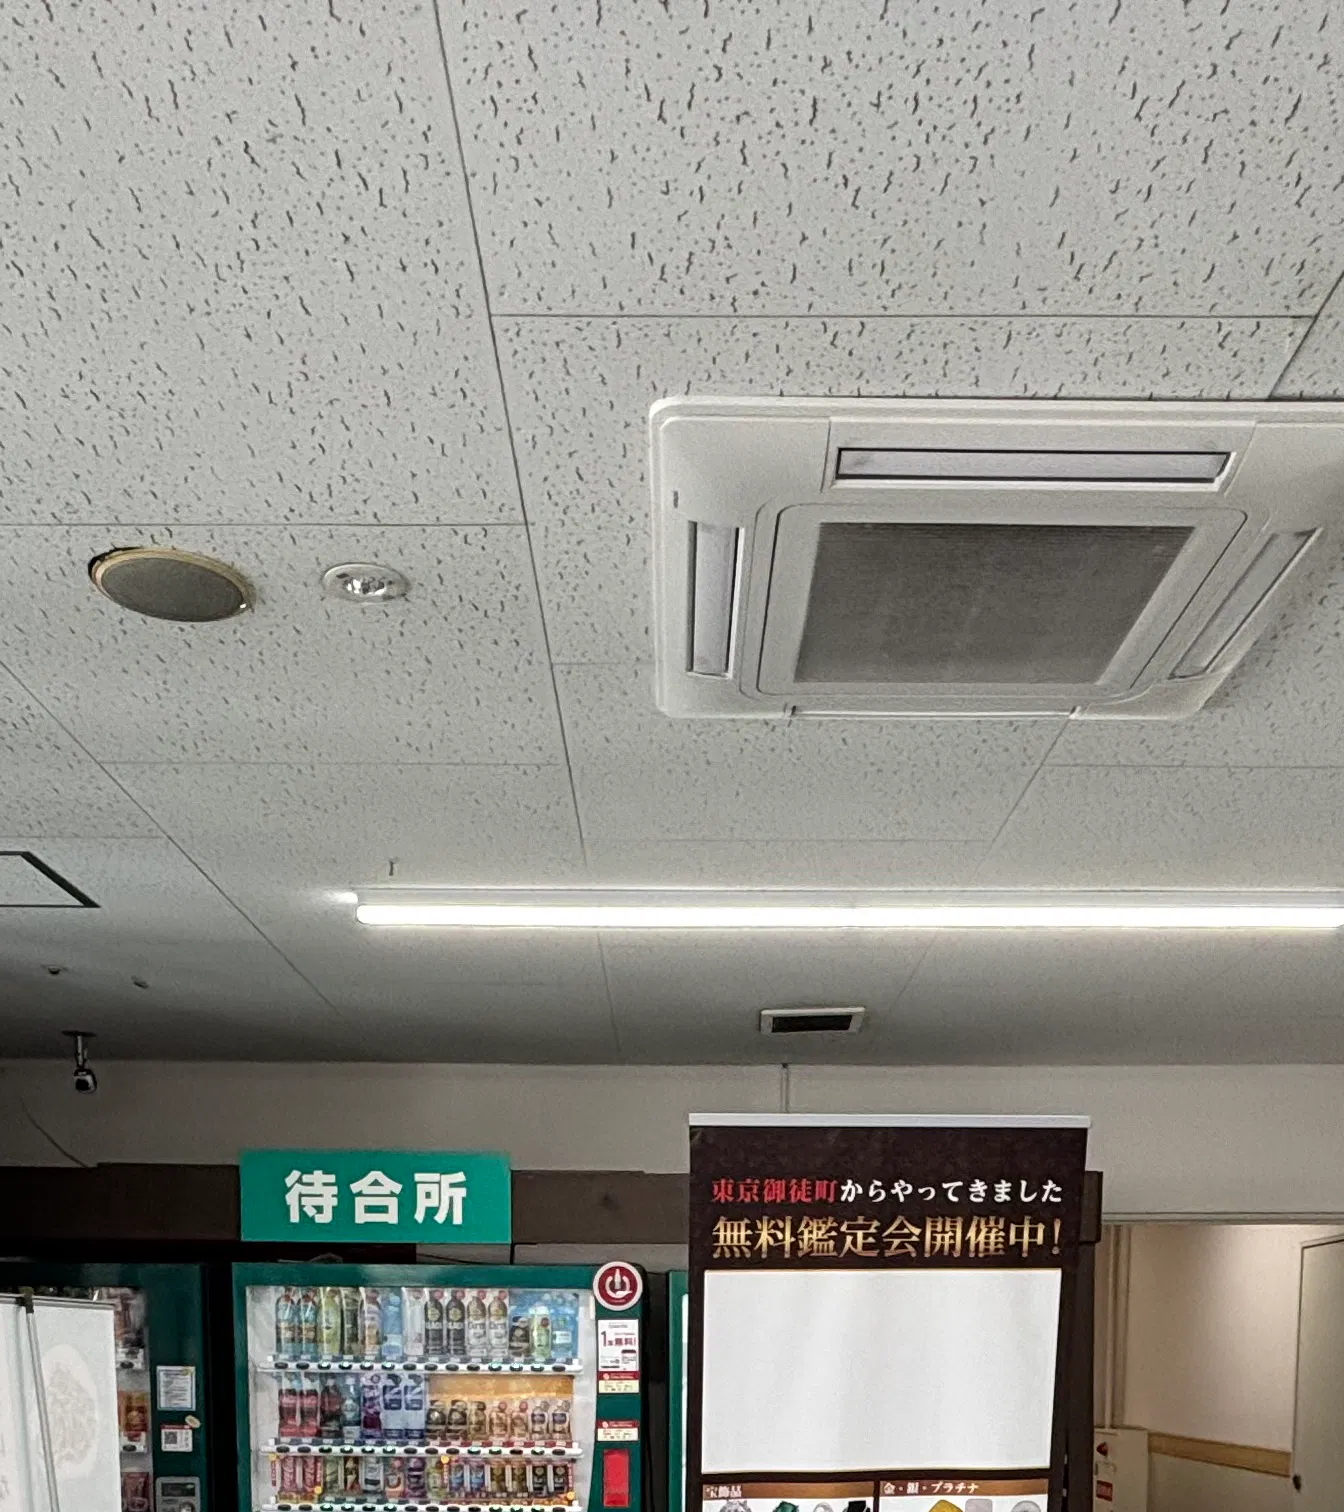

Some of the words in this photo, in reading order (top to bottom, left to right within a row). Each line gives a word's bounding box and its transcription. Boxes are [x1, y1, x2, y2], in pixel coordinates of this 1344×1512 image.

[284, 1169, 467, 1225] 待合所
[711, 1177, 1063, 1204] 東京御徒町からやってきました
[712, 1215, 1062, 1259] 無料鑑定会開催中!
